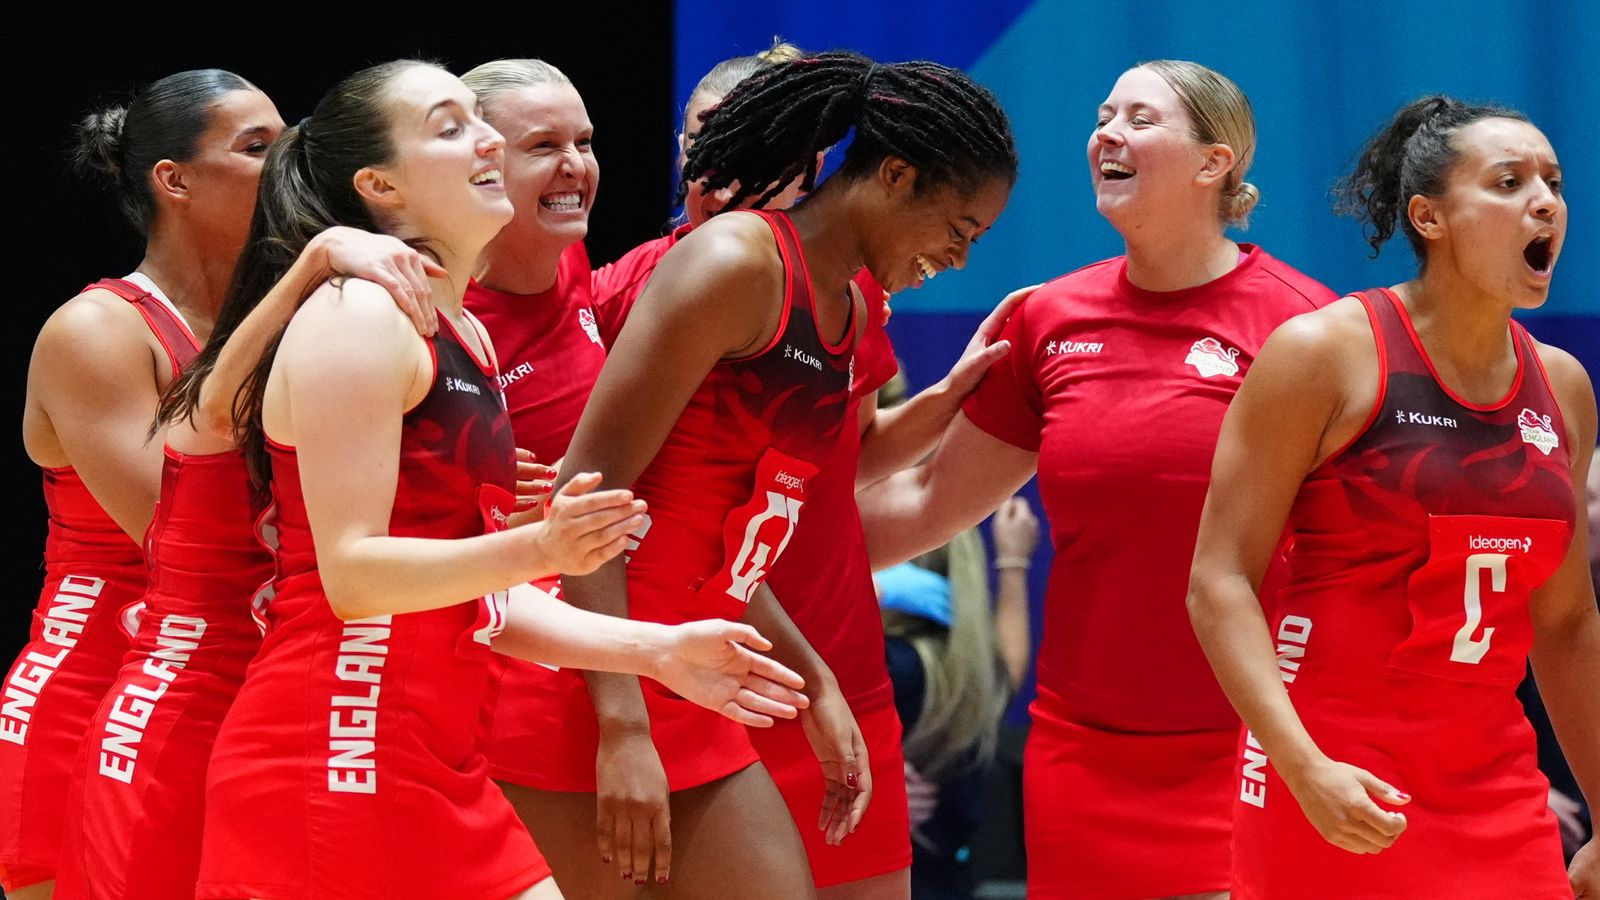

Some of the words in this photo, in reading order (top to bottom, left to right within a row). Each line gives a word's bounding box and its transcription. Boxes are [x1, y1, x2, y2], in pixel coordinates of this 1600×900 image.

[1059, 341, 1104, 354] KUKRI
[793, 348, 823, 371] KUKRI
[500, 361, 534, 389] UKRI
[454, 378, 481, 396] KUKRI
[1409, 412, 1458, 428] KUKRI
[1469, 535, 1521, 552] Ideagen
[0, 574, 106, 746] ENGLAND
[98, 614, 207, 784] ENGLAND
